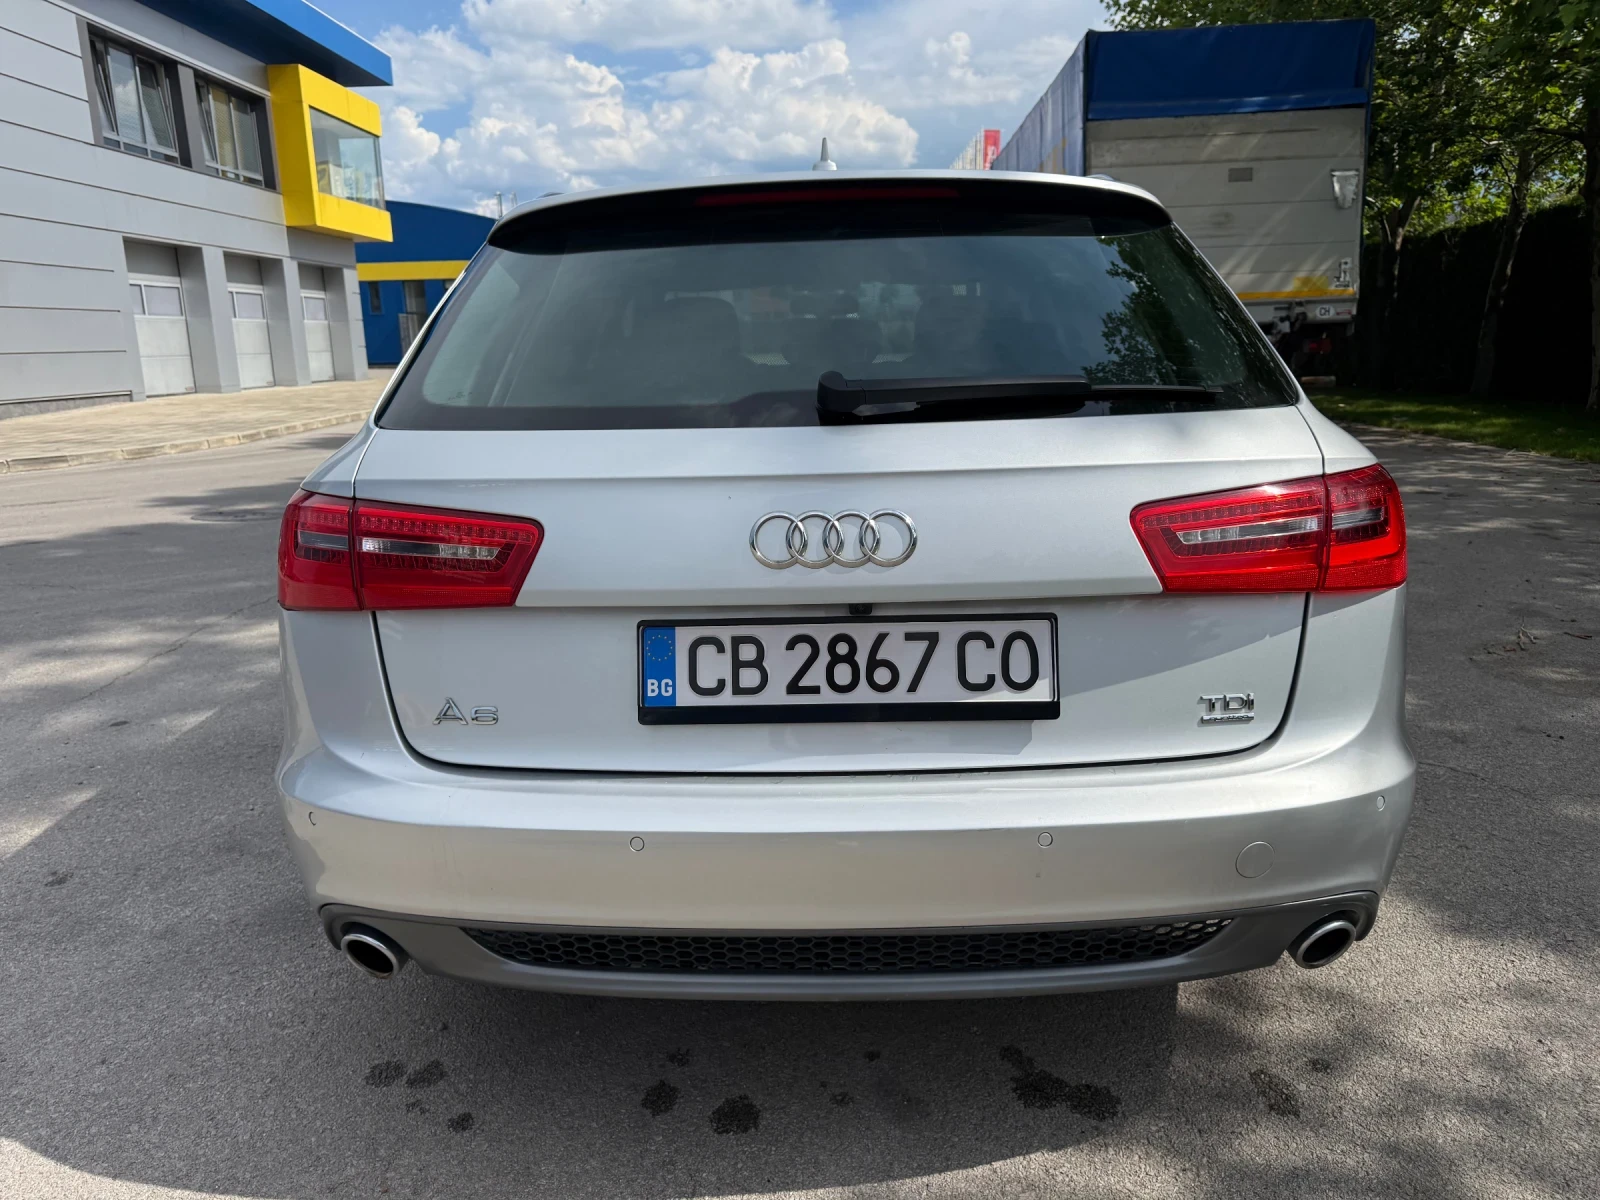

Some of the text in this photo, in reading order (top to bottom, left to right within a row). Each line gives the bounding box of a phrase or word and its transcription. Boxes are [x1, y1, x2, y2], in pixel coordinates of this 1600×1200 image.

[688, 631, 1040, 696] CB 2867 CO
[647, 678, 673, 697] BG
[432, 697, 498, 725] A6
